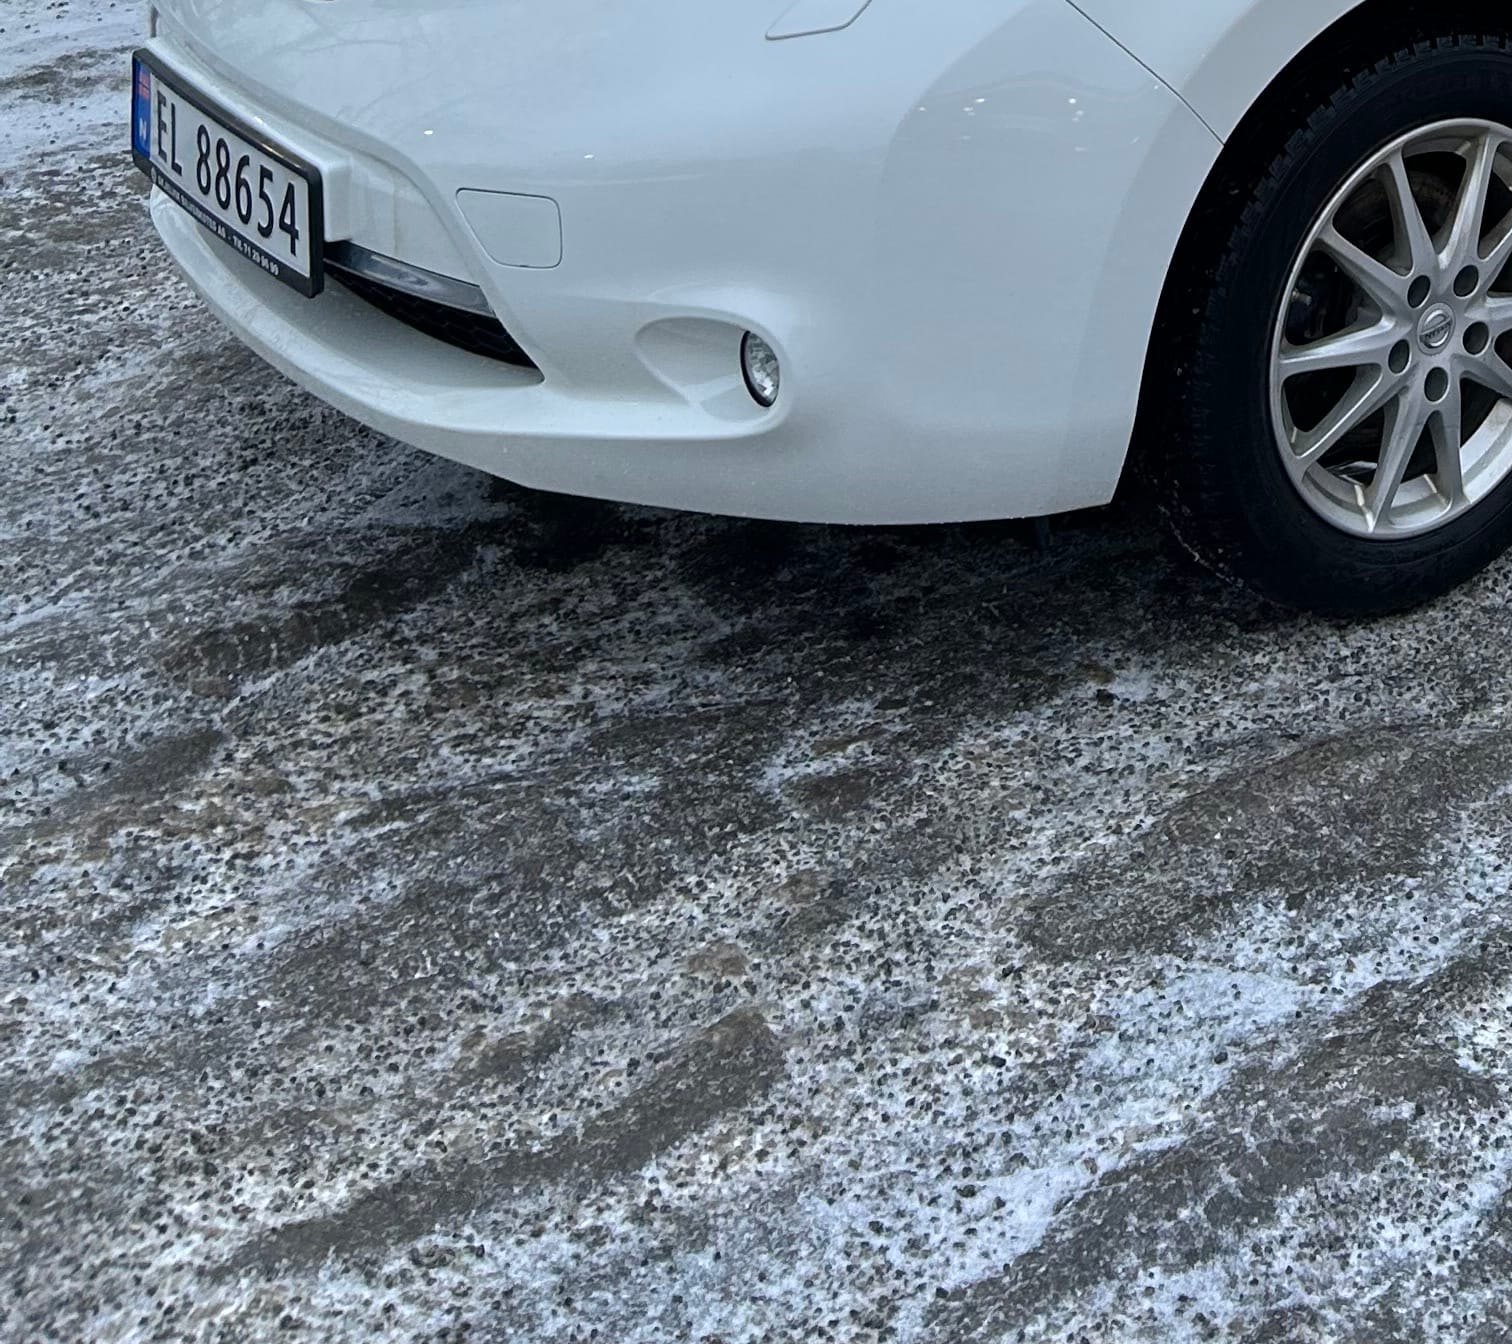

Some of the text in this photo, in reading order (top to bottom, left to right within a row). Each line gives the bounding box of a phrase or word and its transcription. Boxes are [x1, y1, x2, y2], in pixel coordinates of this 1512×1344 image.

[139, 118, 147, 140] N
[157, 90, 182, 176] EL
[197, 124, 299, 256] 88654
